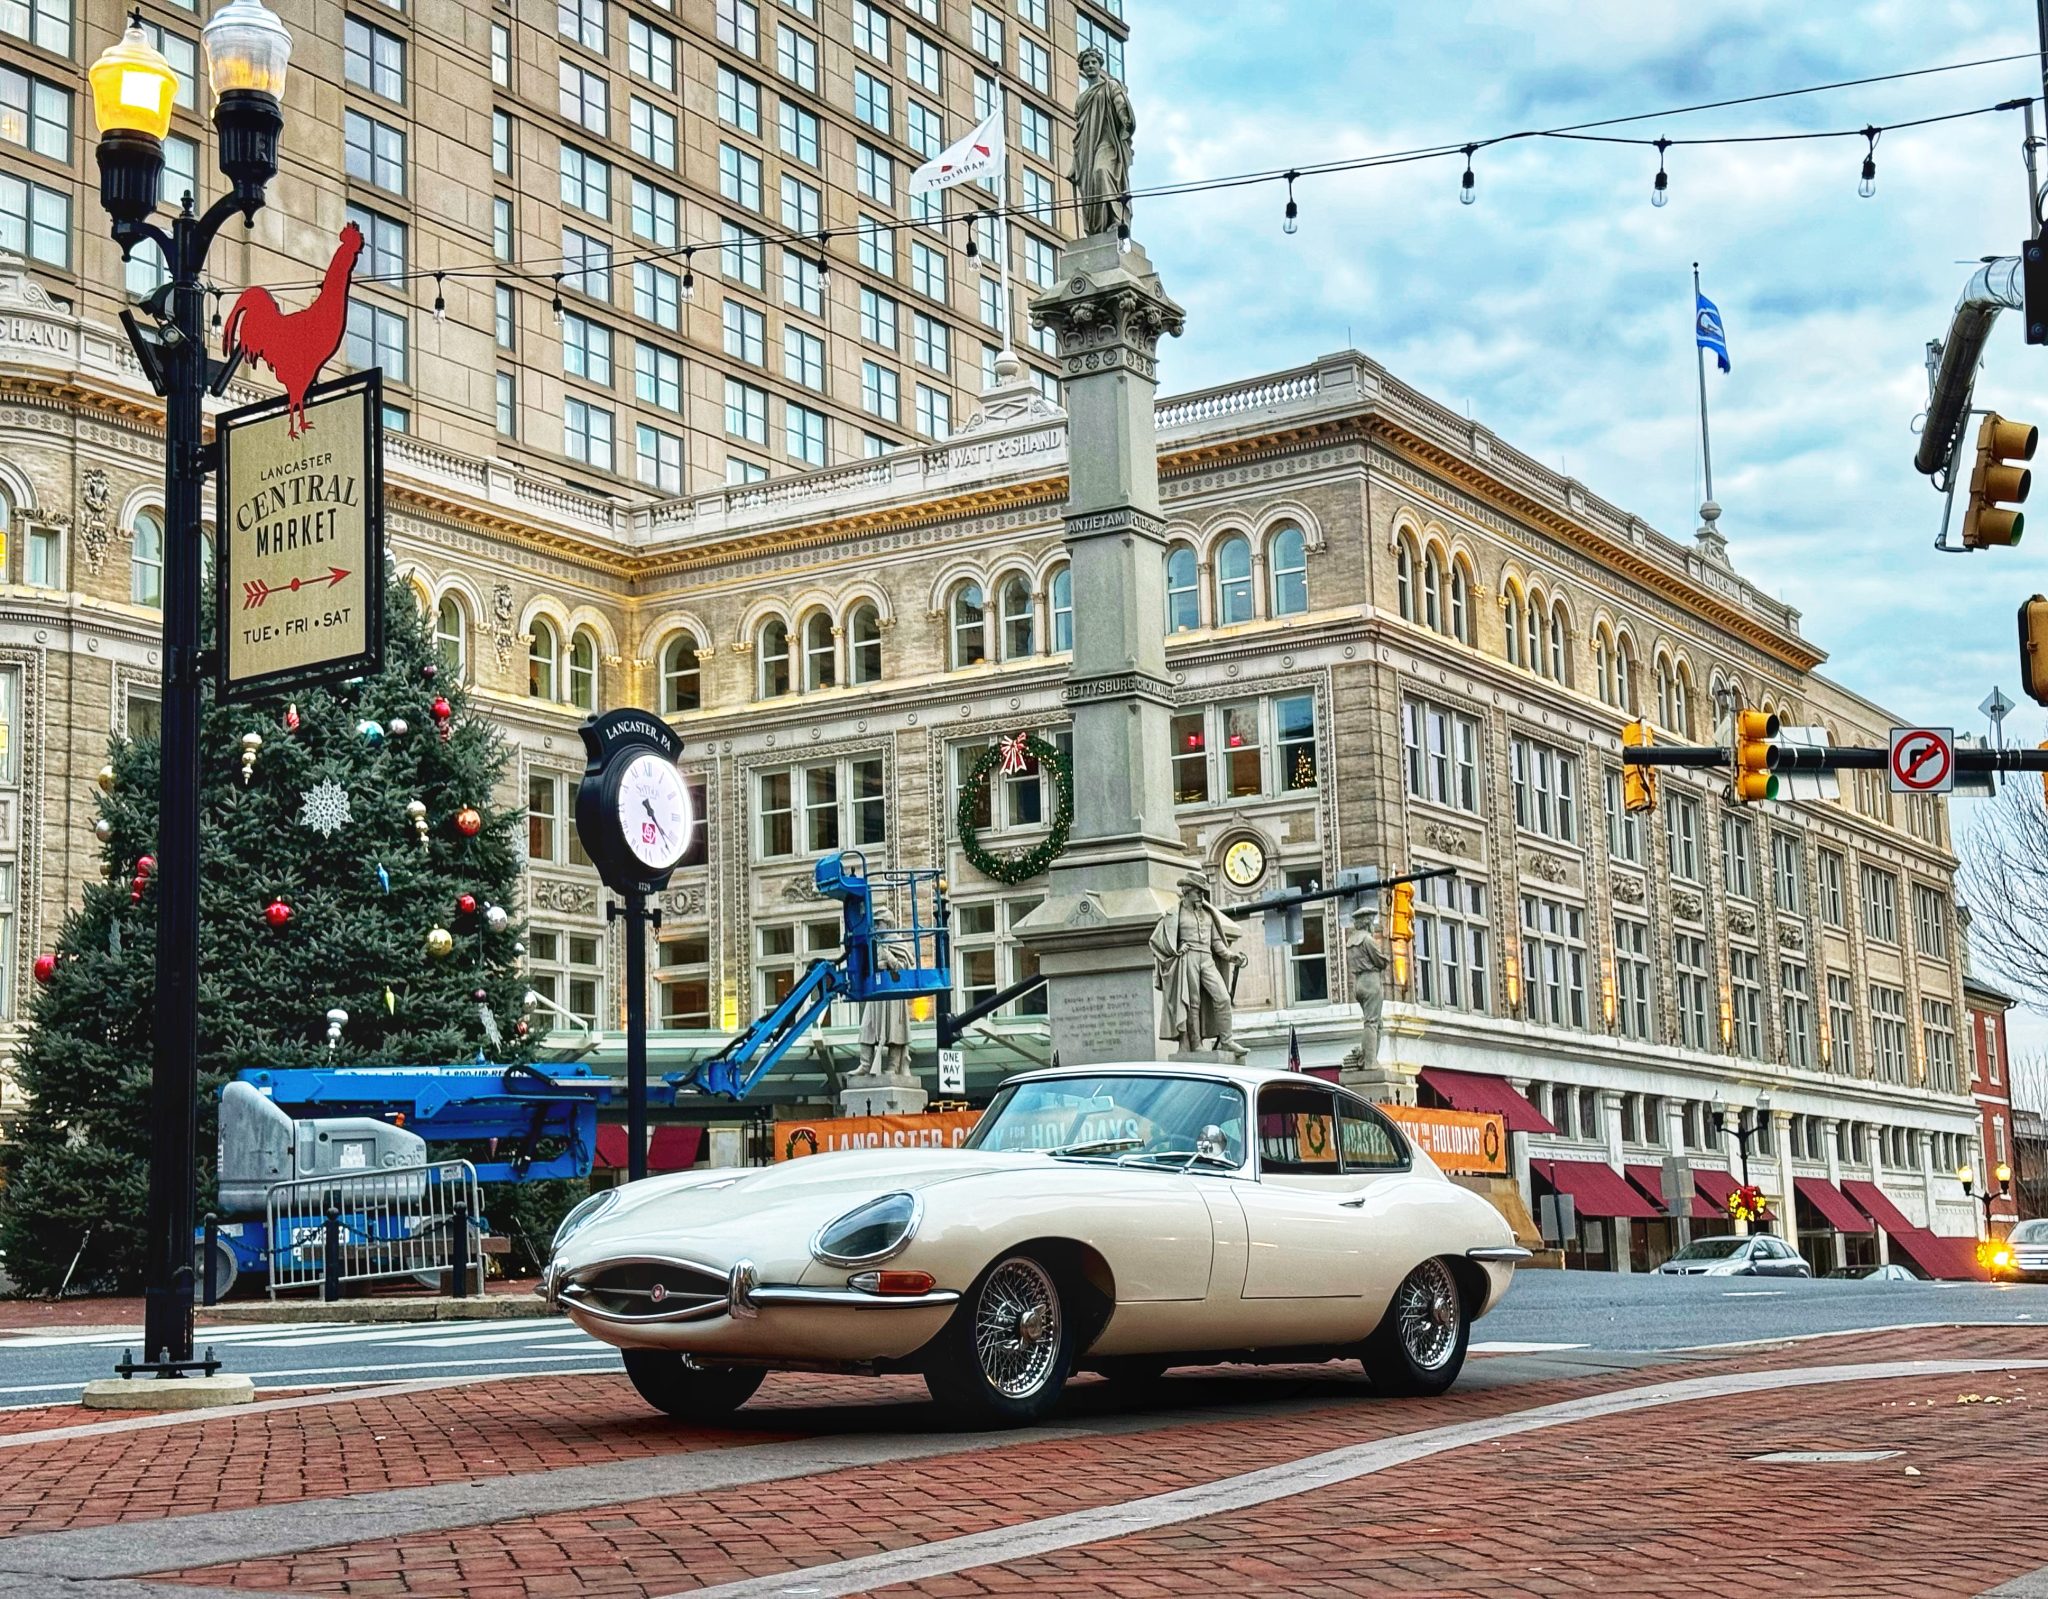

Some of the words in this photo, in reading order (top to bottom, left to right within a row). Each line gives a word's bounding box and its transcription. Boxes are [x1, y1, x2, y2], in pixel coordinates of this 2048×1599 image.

[953, 444, 993, 469] WATT
[997, 441, 1009, 460] &
[1011, 430, 1062, 458] SHAND
[260, 452, 333, 481] LANCASTER
[236, 474, 359, 532] CENTRAL
[256, 508, 337, 558] MARKET
[1068, 511, 1127, 535] ANTIETAM
[243, 625, 272, 645] TUE
[285, 617, 308, 636] FRI
[323, 608, 351, 628] SAT
[1067, 677, 1135, 698] GETTYSBURG
[605, 720, 659, 743] LANCASTER,
[660, 734, 672, 752] PA
[638, 881, 651, 891] 1729
[943, 1052, 960, 1063] ONE
[943, 1064, 960, 1075] WAY
[828, 1128, 943, 1152] LANCASTER
[1031, 1118, 1139, 1150] HOLDAYS
[1329, 1120, 1388, 1157] LNCASTER
[1432, 1123, 1480, 1156] HOLIDAYS
